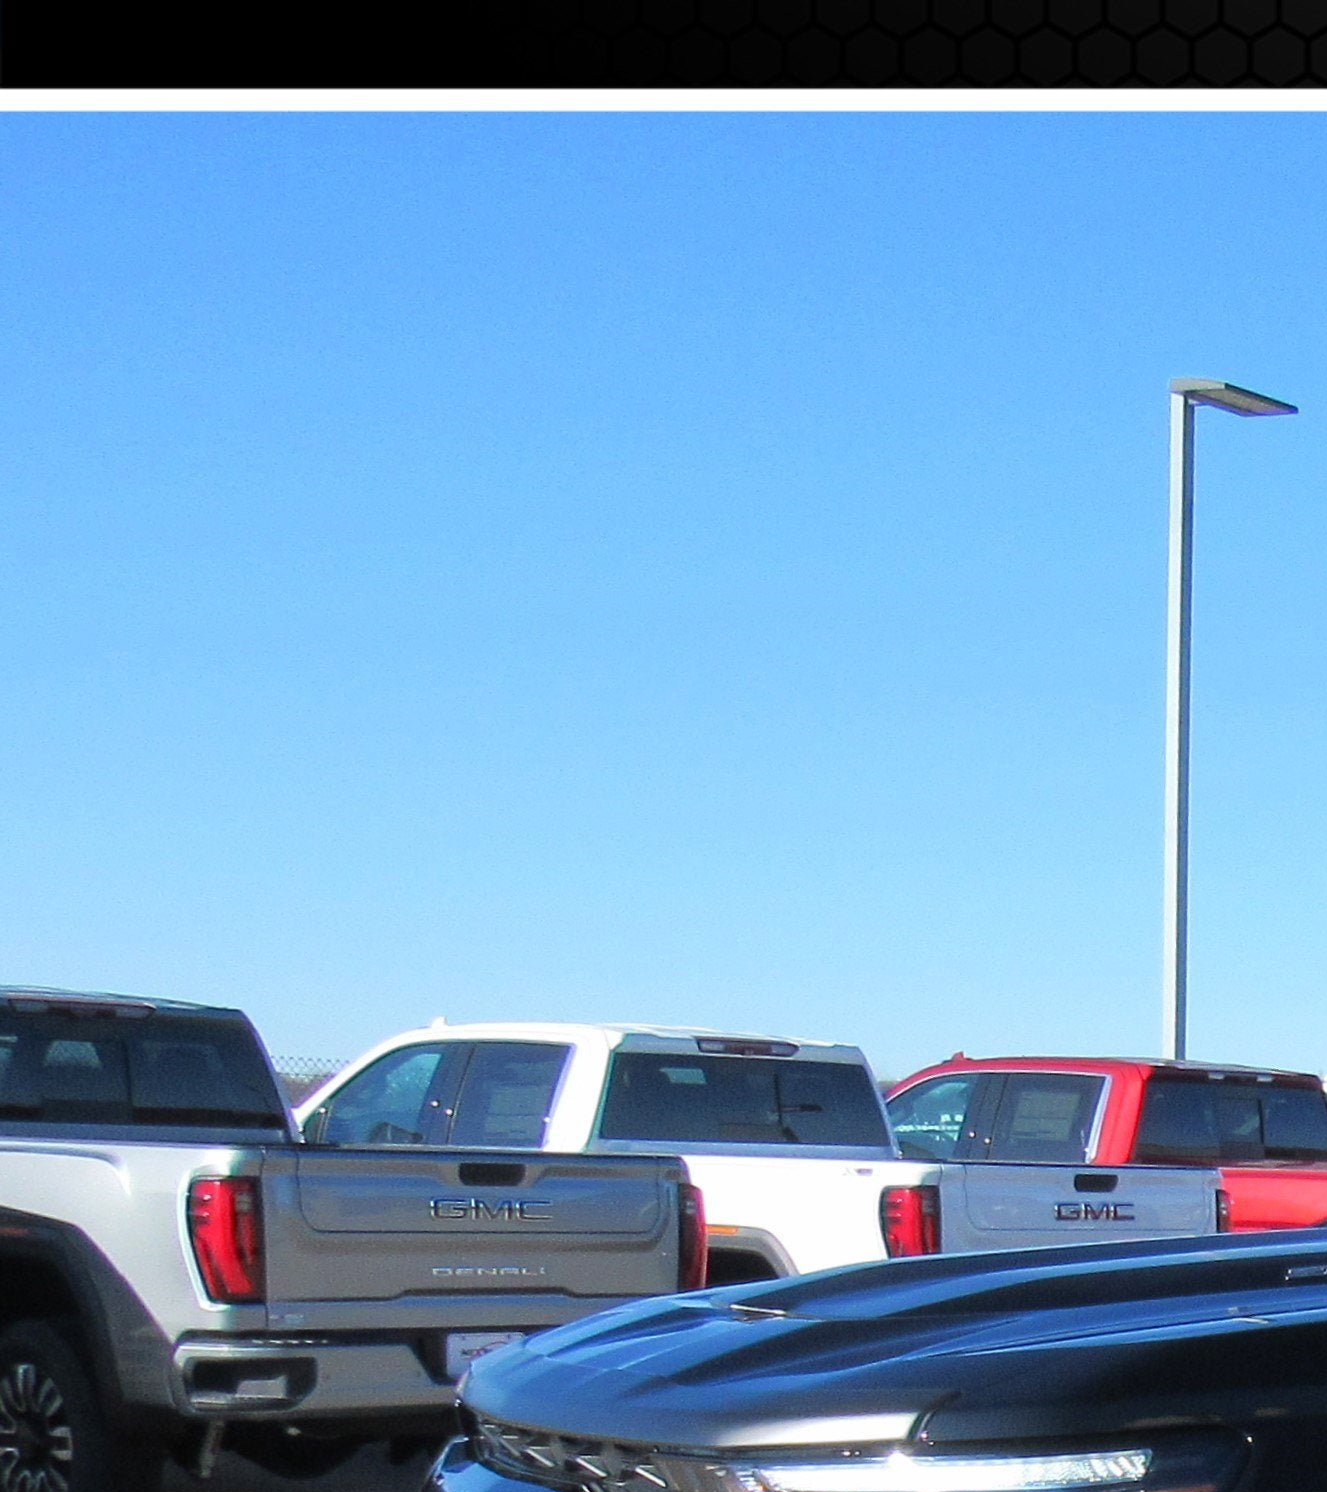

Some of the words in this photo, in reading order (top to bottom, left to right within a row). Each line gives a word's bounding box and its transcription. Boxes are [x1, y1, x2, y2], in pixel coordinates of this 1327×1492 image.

[430, 1198, 554, 1222] GMC
[1054, 1202, 1136, 1221] GMC
[432, 1265, 547, 1278] DENALI
